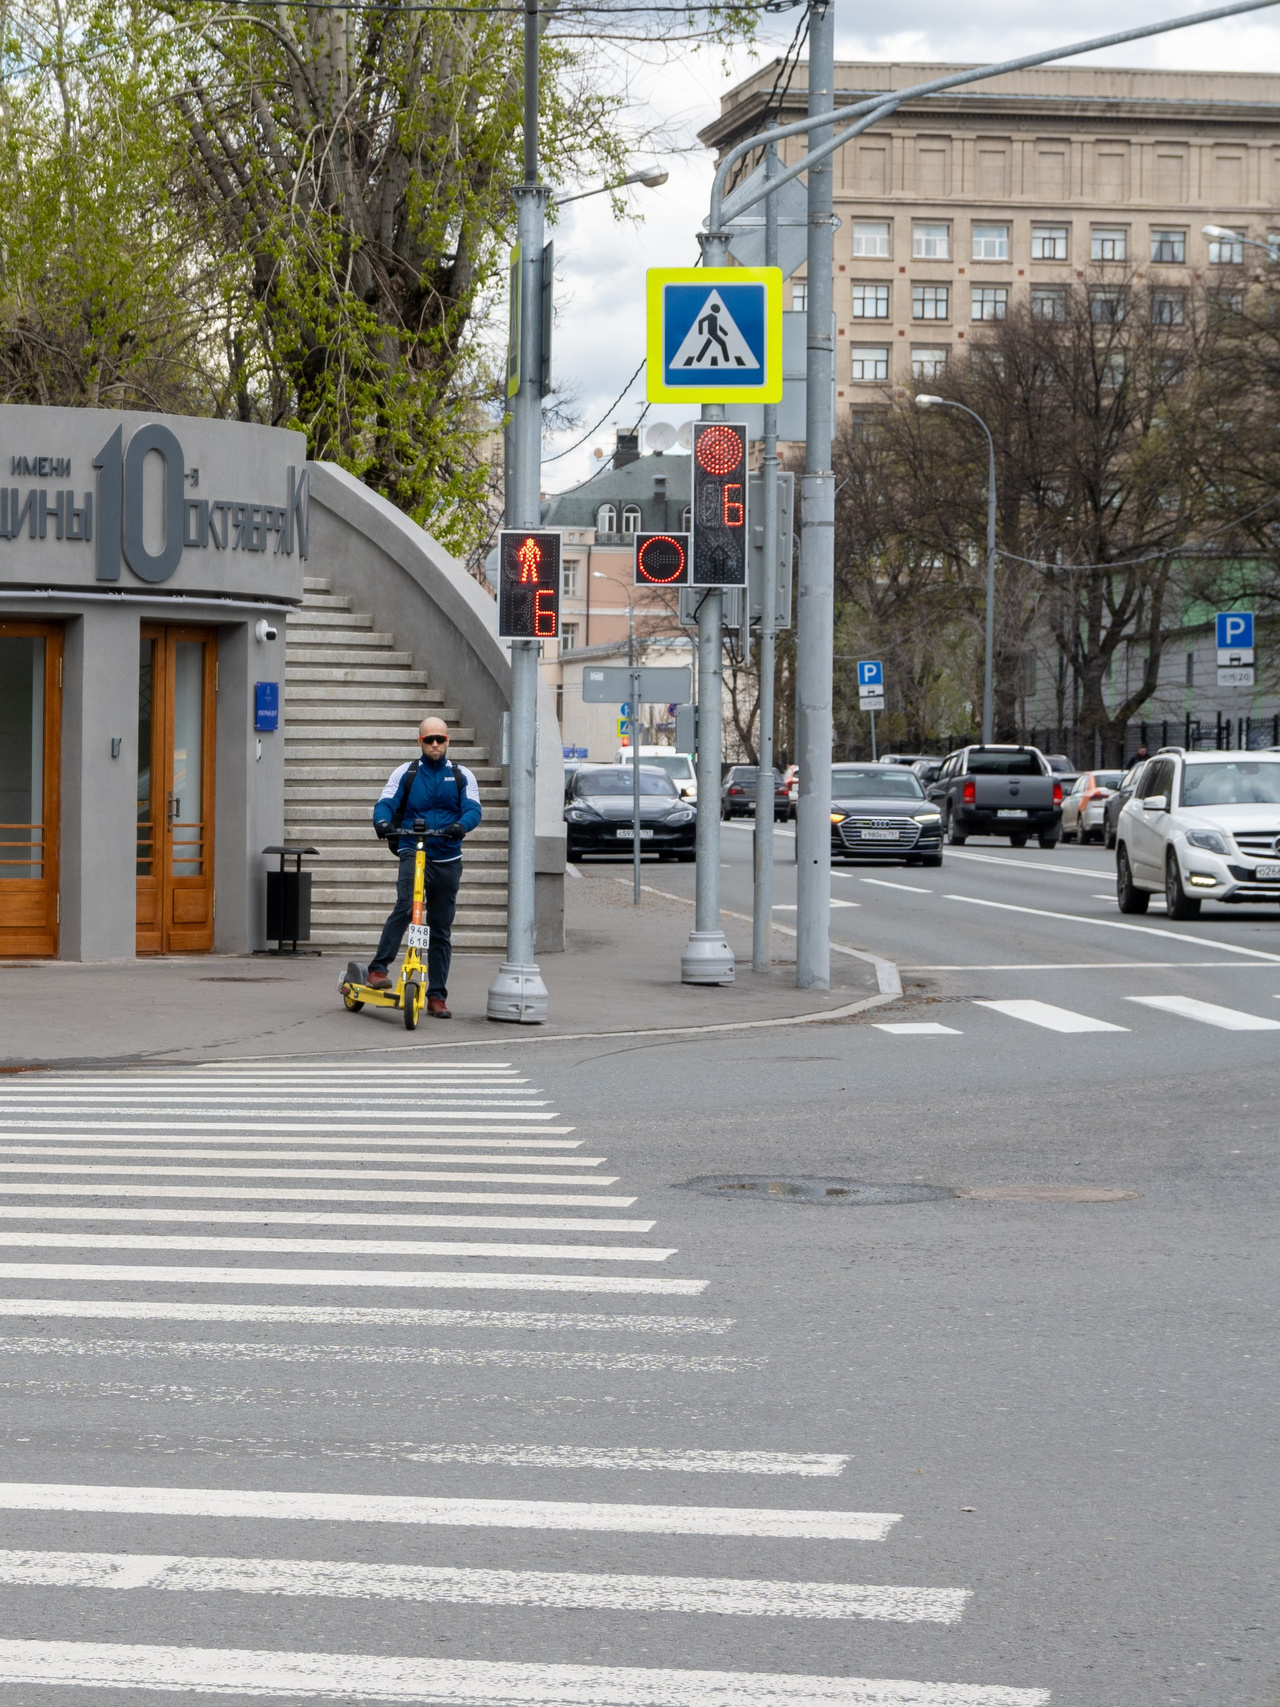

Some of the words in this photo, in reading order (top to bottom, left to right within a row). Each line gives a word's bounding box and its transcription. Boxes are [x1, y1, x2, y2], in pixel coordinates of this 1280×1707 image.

[11, 456, 71, 477] ИМЕНИ
[183, 499, 287, 555] ОКТЯБРЯ
[1226, 617, 1246, 645] P
[864, 664, 878, 683] P
[1238, 673, 1249, 681] 20
[410, 925, 429, 936] 948
[409, 937, 428, 947] 618
